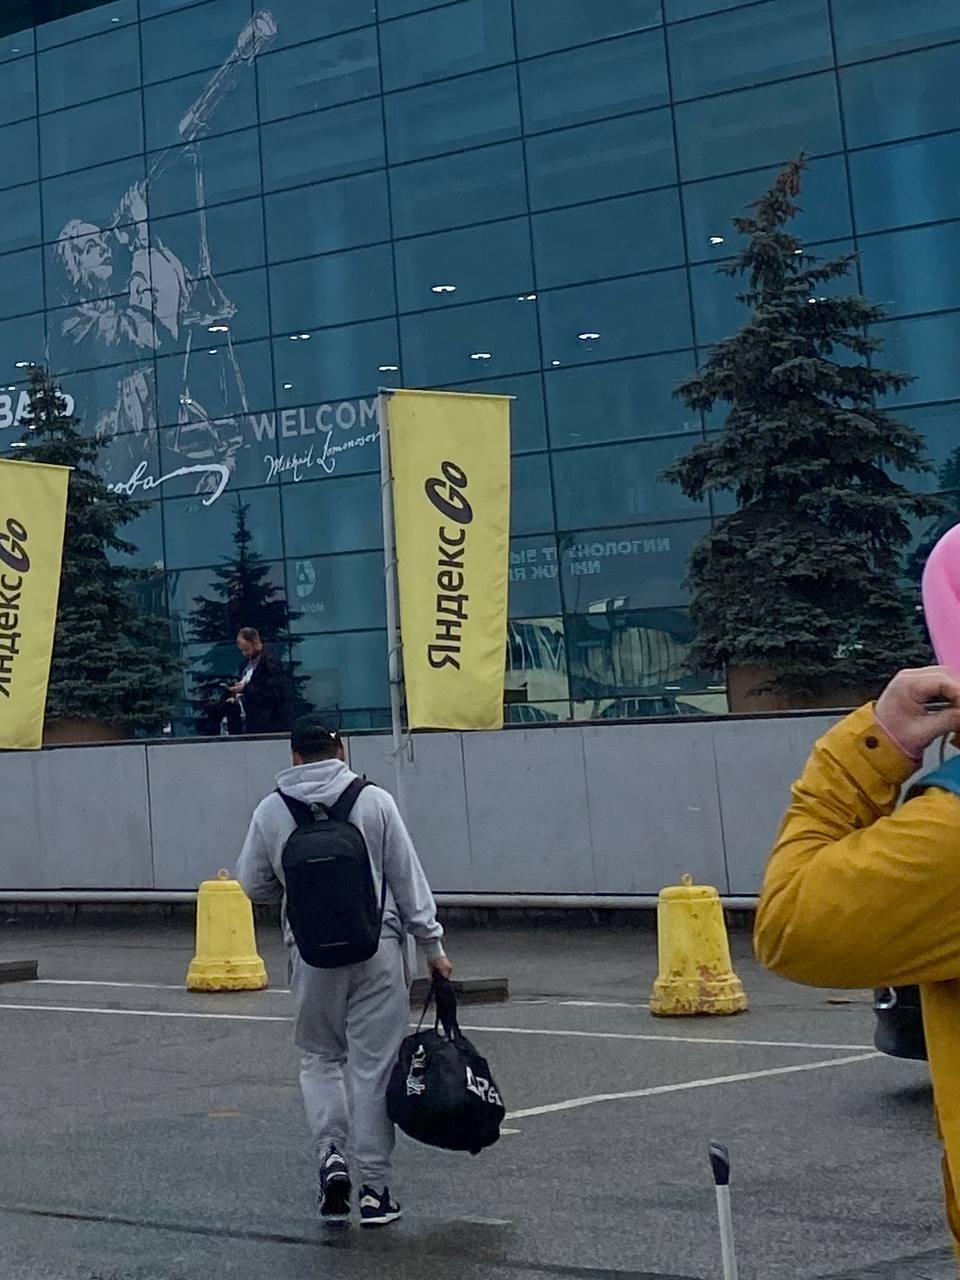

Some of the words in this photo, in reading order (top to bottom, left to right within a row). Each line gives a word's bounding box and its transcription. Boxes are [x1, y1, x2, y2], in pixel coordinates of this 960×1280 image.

[249, 397, 381, 442] WELCOM
[424, 460, 474, 525] Go
[427, 526, 469, 671] Яндекс
